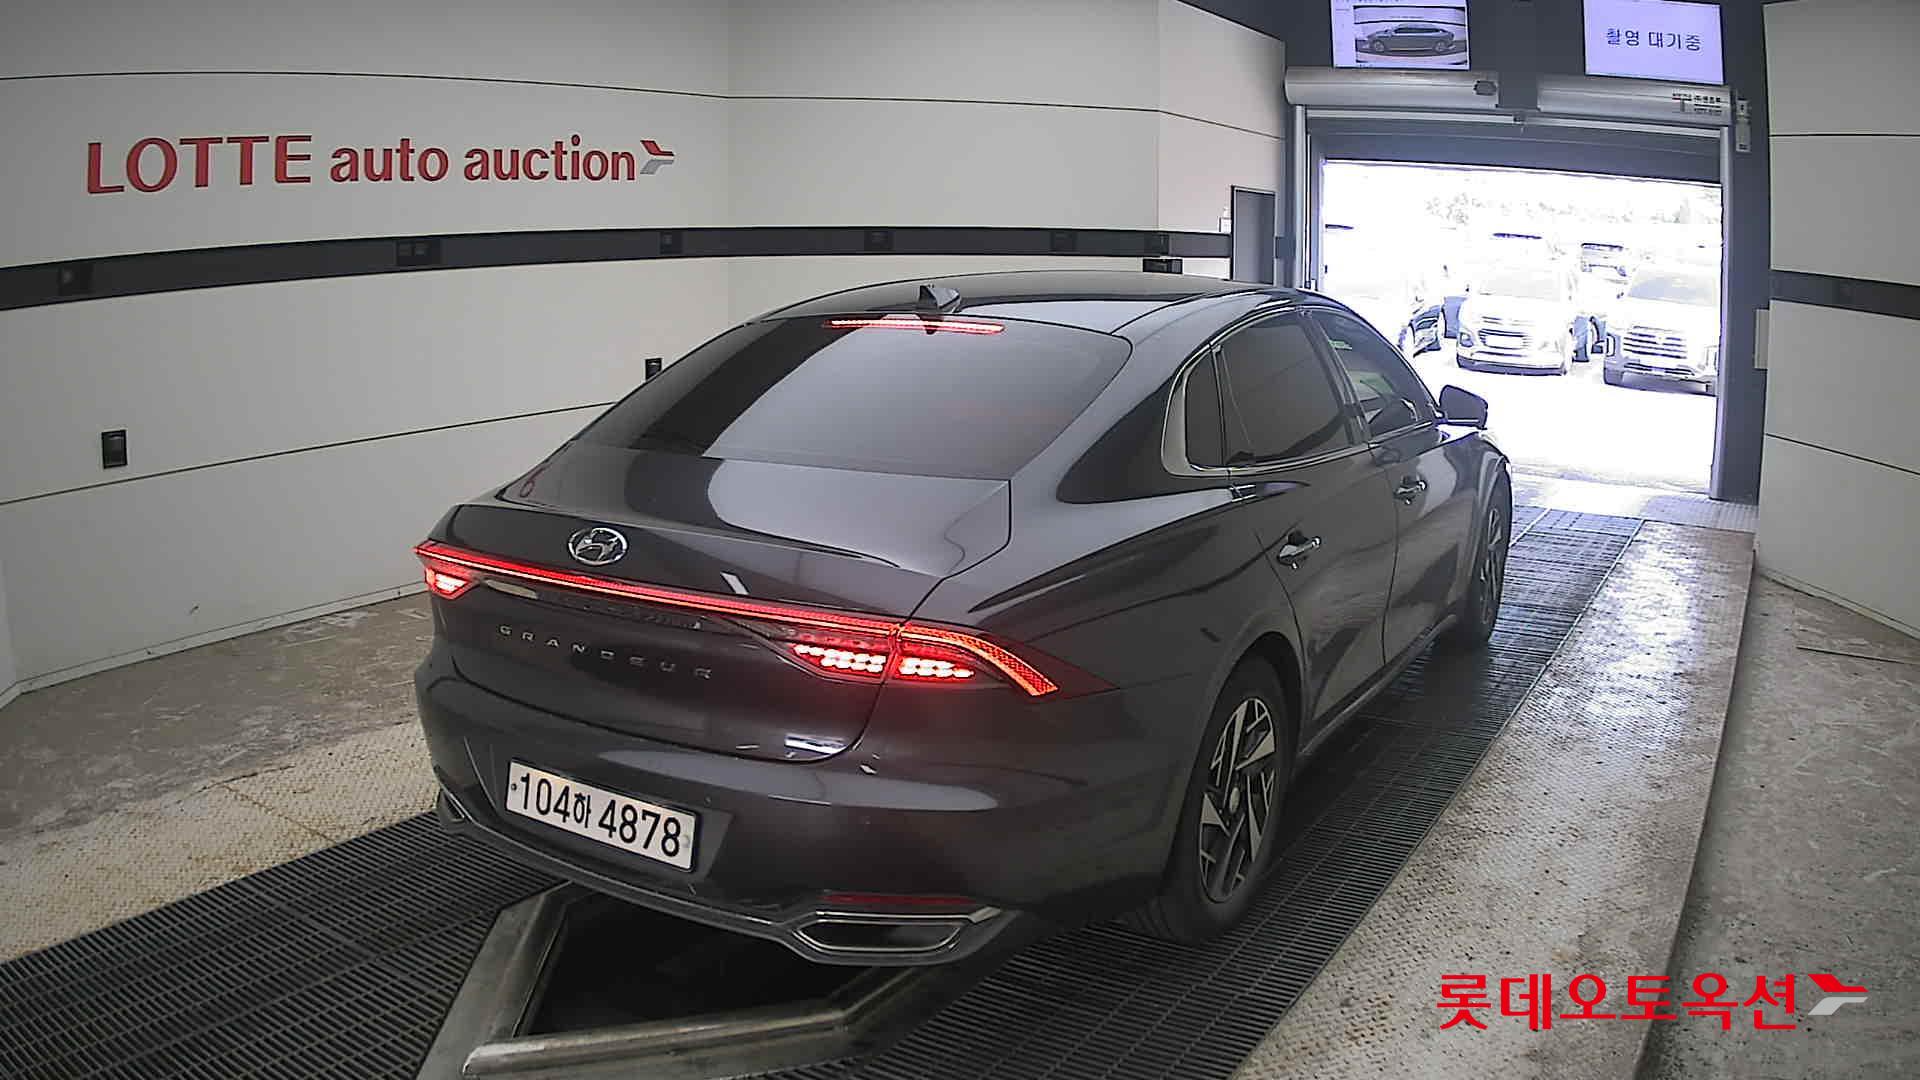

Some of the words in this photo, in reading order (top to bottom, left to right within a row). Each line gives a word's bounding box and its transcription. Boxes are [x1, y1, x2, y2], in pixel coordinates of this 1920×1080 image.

[1606, 27, 1640, 47] 촬영
[1648, 31, 1701, 51] 대기중
[87, 134, 312, 195] LOTTE
[329, 138, 449, 183] auto
[463, 133, 636, 182] auction
[499, 624, 713, 680] GRANDEUR
[520, 772, 592, 829] 104하
[598, 799, 682, 858] 4878
